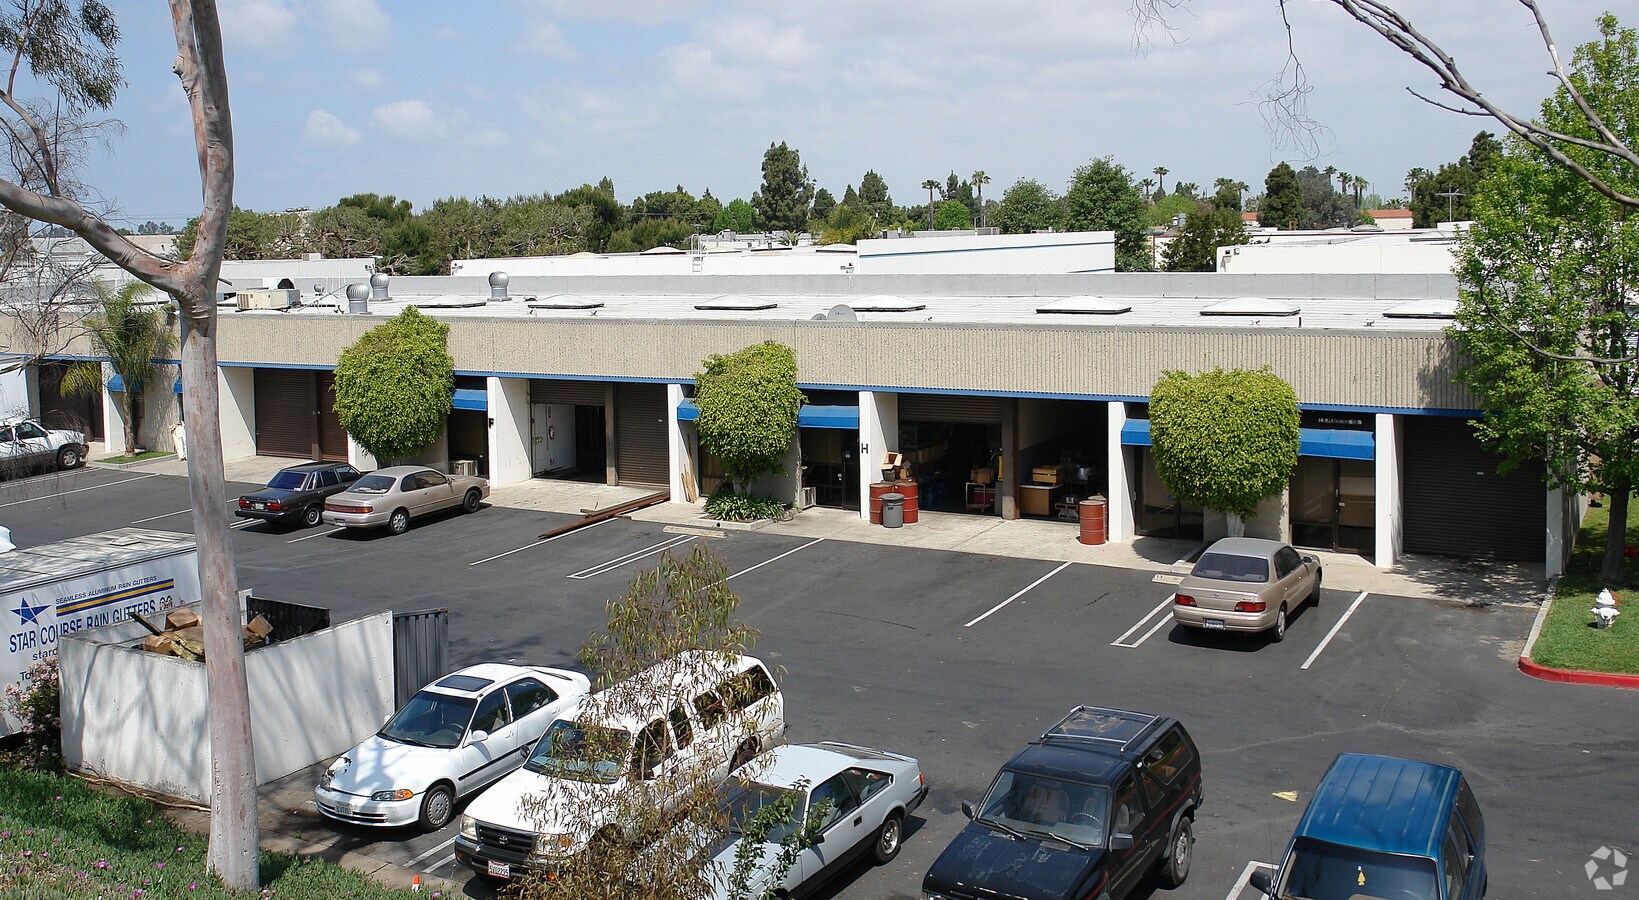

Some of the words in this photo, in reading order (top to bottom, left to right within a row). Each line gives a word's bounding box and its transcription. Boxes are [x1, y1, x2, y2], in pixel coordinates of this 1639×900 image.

[488, 417, 495, 430] F
[860, 442, 869, 455] H
[55, 592, 87, 605] SEAMLESS
[88, 585, 117, 597] ALUMINUM
[118, 581, 132, 590] RAIN
[132, 575, 158, 587] GUTTERS
[9, 629, 37, 653] STAR
[40, 618, 82, 646] COURSE
[86, 611, 110, 629] RAIN
[112, 599, 156, 624] GUTTERS
